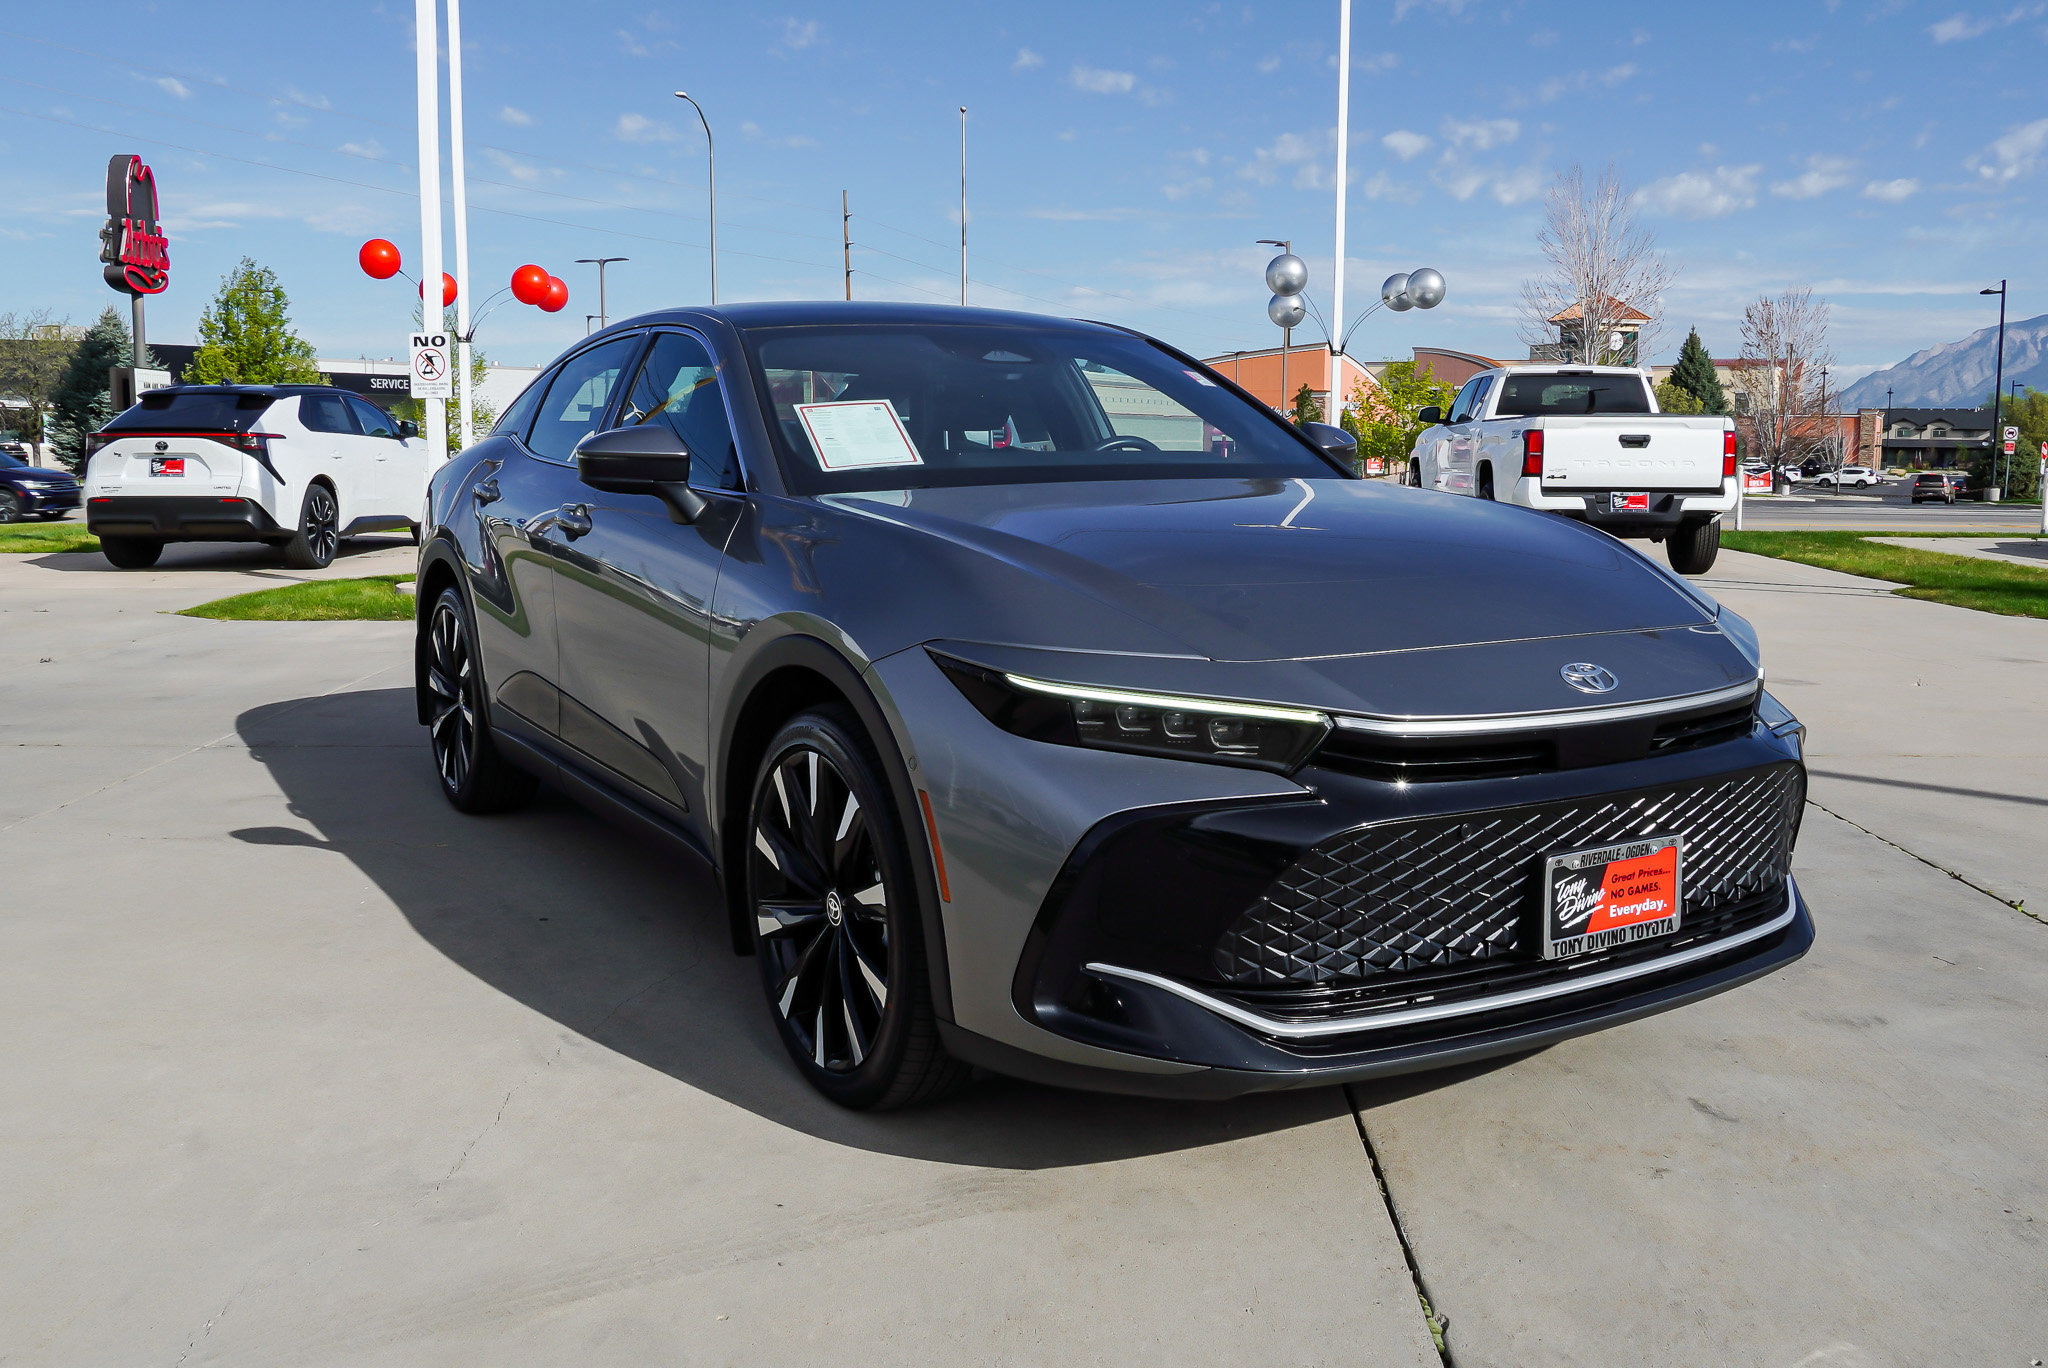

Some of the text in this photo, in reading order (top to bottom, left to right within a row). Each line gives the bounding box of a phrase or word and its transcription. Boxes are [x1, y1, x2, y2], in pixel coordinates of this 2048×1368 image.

[413, 335, 446, 347] NO
[370, 378, 410, 390] SERVICE
[1573, 458, 1697, 468] TACOMA
[1580, 849, 1621, 867] RIVERDALE
[1625, 843, 1651, 859] OGDEN
[1611, 872, 1635, 884] Great
[1555, 873, 1588, 903] Tony
[1611, 882, 1661, 899] NO GAMES.
[1555, 888, 1607, 921] Divino
[1609, 898, 1668, 918] Everyday.
[1552, 918, 1674, 957] TONY DIVINO TOYOTA
